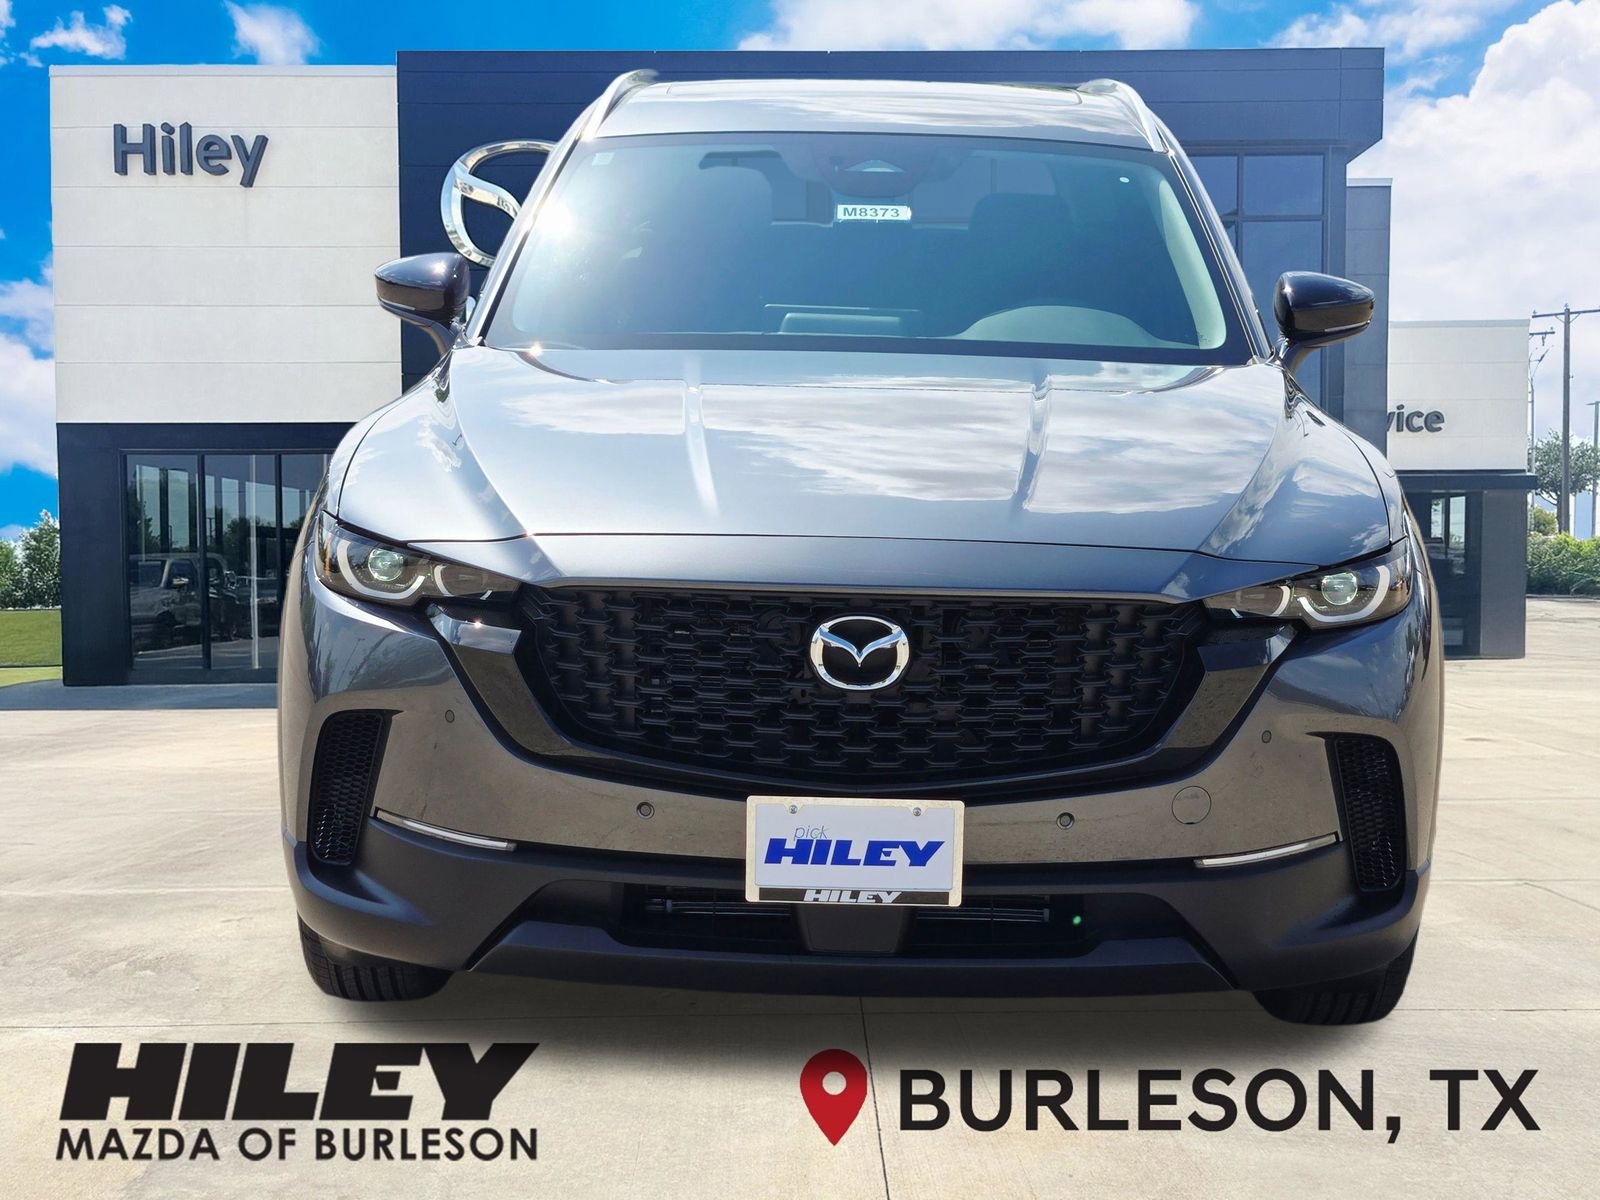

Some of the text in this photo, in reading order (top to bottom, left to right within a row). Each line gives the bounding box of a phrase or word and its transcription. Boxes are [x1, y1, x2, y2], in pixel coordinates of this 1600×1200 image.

[113, 121, 269, 188] Hiley
[843, 207, 900, 217] M8373
[793, 825, 828, 841] pick
[764, 838, 945, 867] HILEY
[803, 889, 902, 904] HILEY
